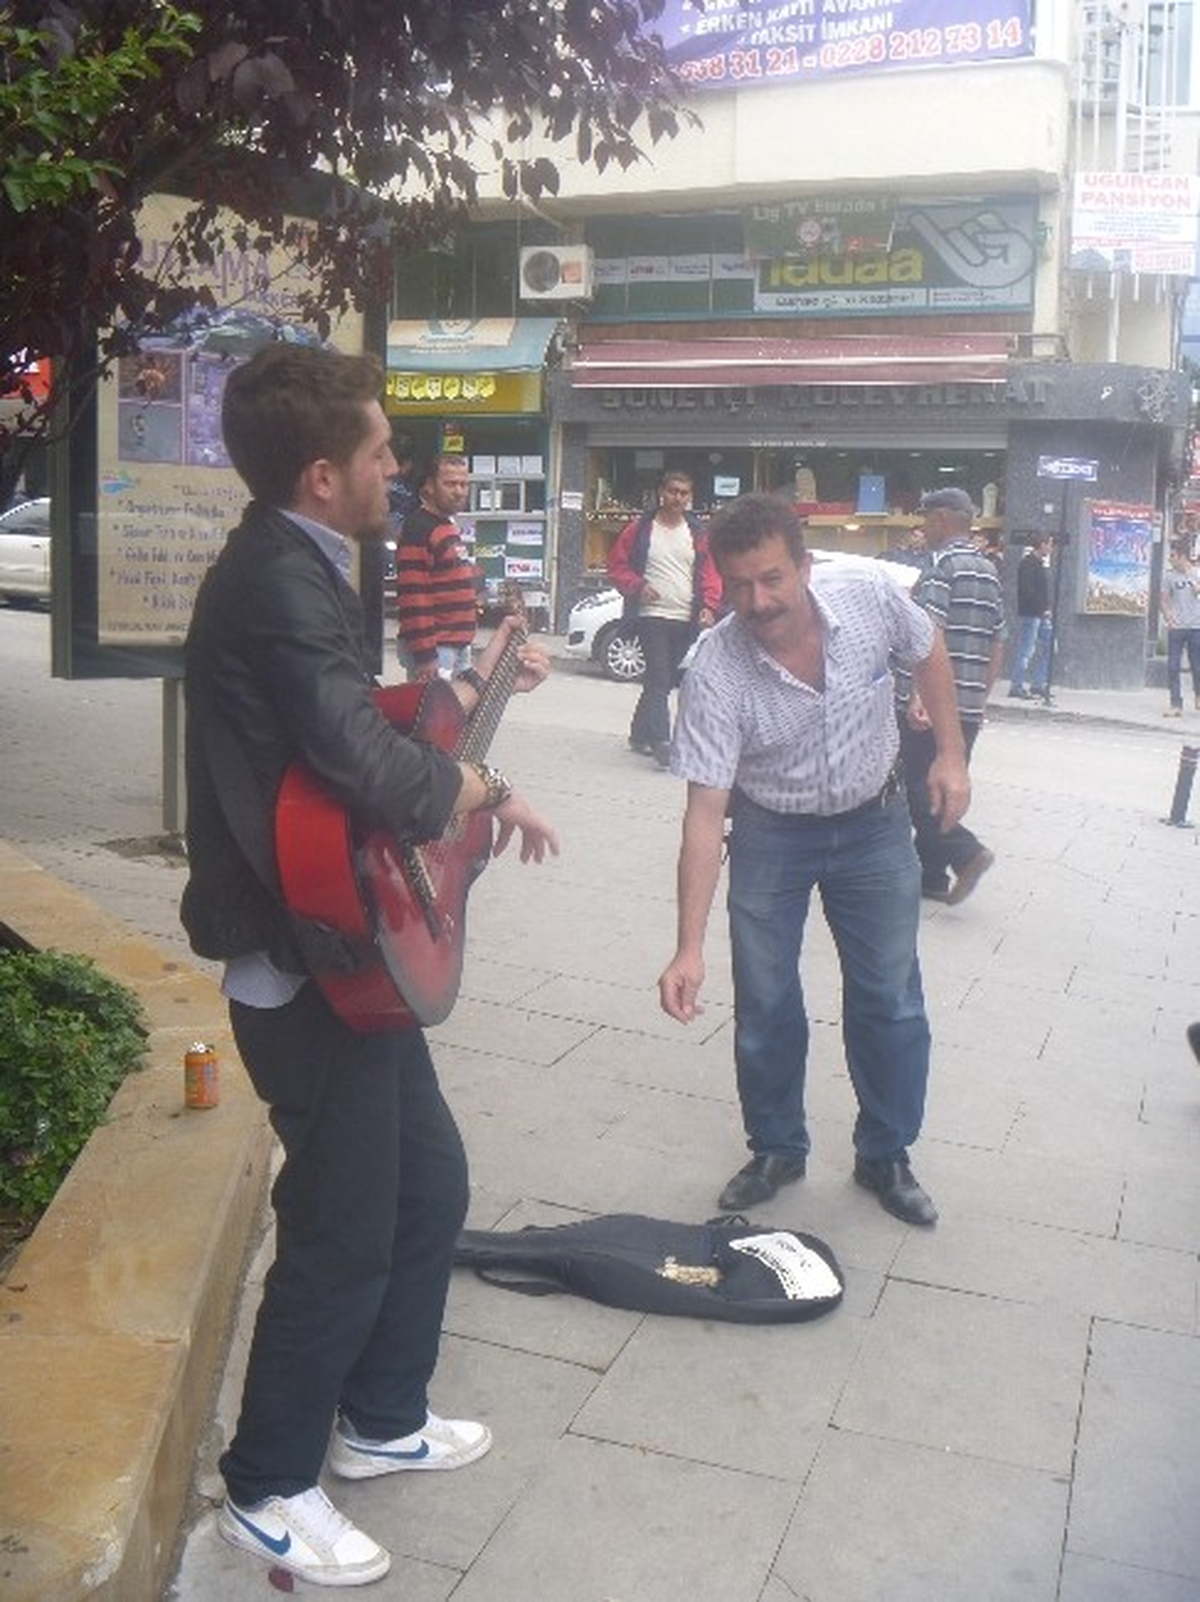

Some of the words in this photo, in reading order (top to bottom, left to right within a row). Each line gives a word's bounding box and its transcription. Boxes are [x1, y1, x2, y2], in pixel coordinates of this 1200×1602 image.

[695, 11, 762, 35] ERKEN
[729, 49, 763, 79] 31
[766, 47, 799, 75] 21
[820, 33, 886, 68] 0228
[889, 28, 942, 60] 212
[945, 22, 982, 52] 73
[987, 16, 1023, 50] 14
[783, 200, 810, 218] TV
